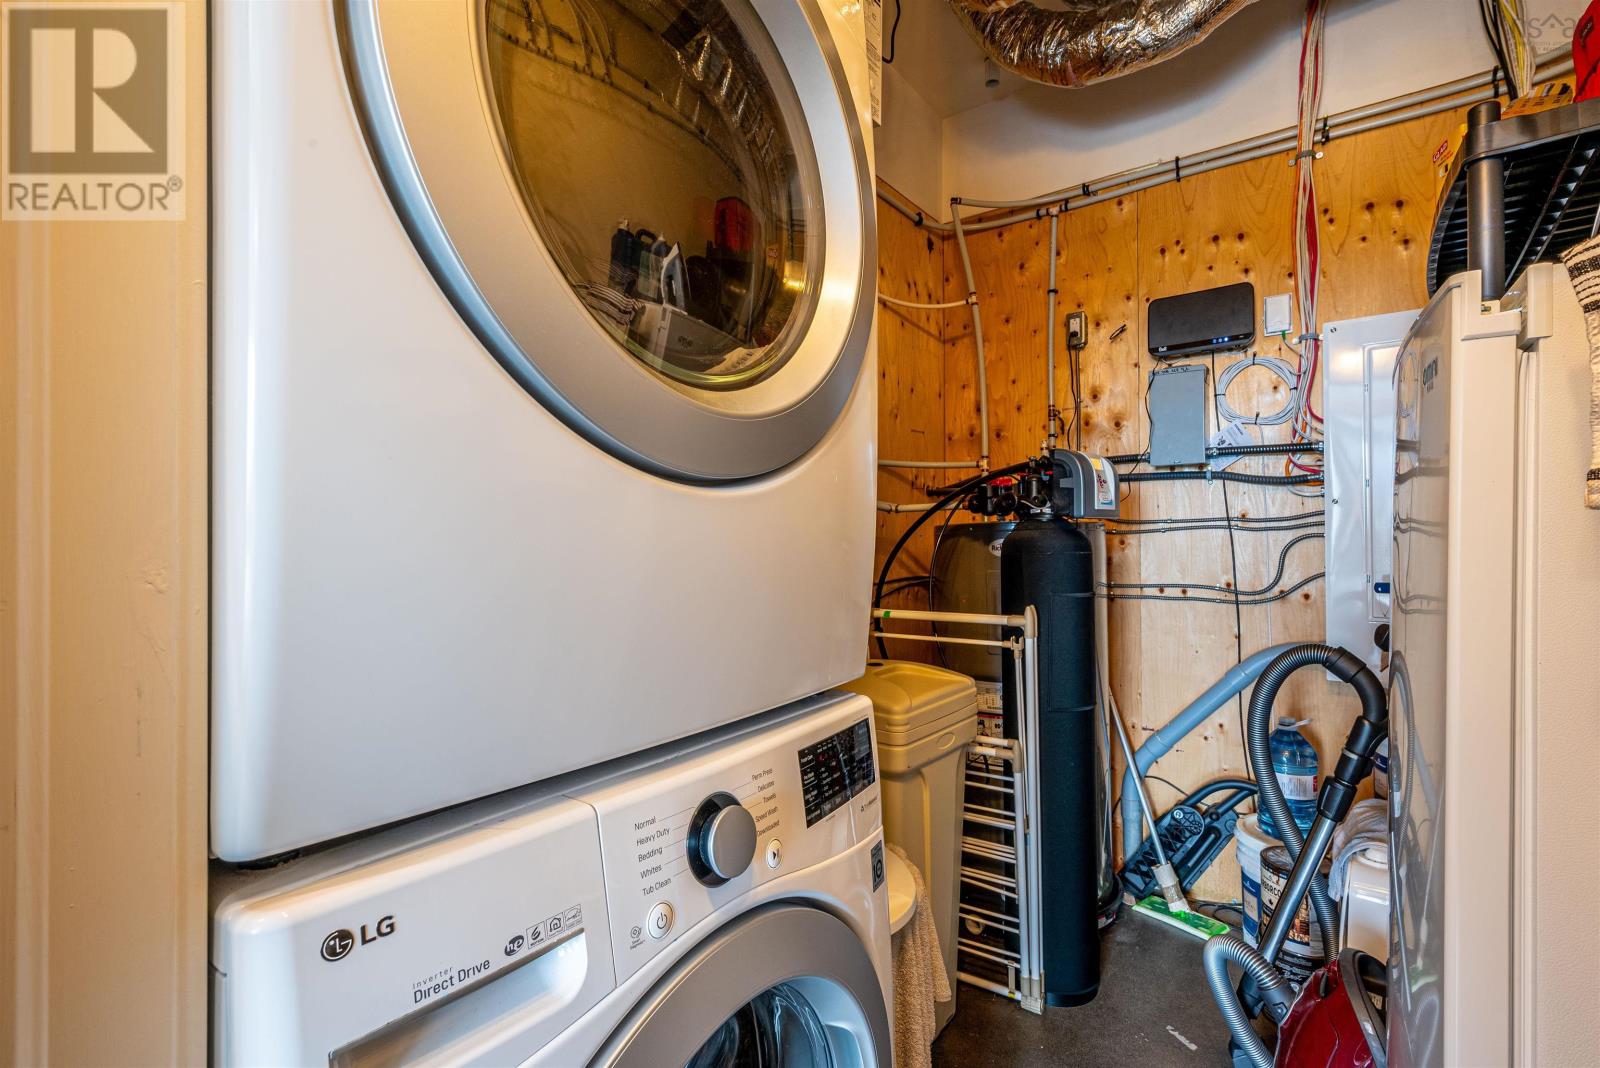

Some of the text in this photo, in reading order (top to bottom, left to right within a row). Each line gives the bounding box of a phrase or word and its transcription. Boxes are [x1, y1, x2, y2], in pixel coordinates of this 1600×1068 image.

[634, 816, 656, 831] Normal
[755, 811, 767, 823] Speed
[636, 827, 670, 847] Heavy Duty
[638, 846, 663, 863] Bedding
[640, 864, 662, 880] Whites
[642, 877, 672, 897] Tub Clean
[360, 915, 396, 946] LG
[412, 967, 453, 989] Inverter
[413, 959, 491, 1004] Direct Drive
